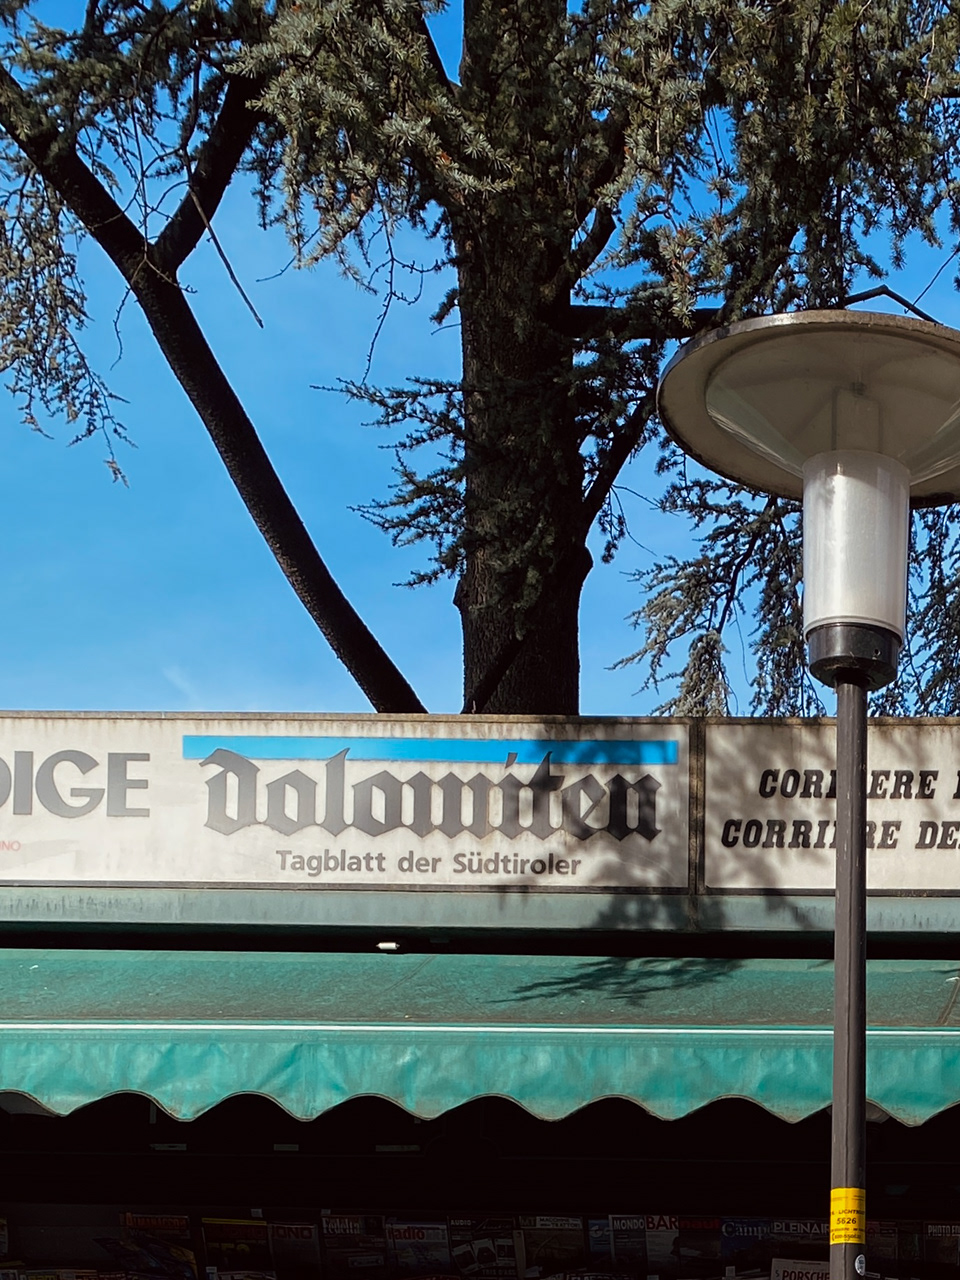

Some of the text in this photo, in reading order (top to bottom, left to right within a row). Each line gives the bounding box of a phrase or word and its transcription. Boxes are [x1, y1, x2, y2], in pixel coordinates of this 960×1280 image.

[200, 747, 663, 842] Dolomiten
[759, 769, 936, 799] CORERE
[721, 818, 902, 849] CORRIRE
[276, 849, 581, 876] Tagblatt der Südtiroler
[613, 1218, 645, 1230] MONDO
[836, 1217, 857, 1225] 5626
[928, 1224, 950, 1236] PHOTO
